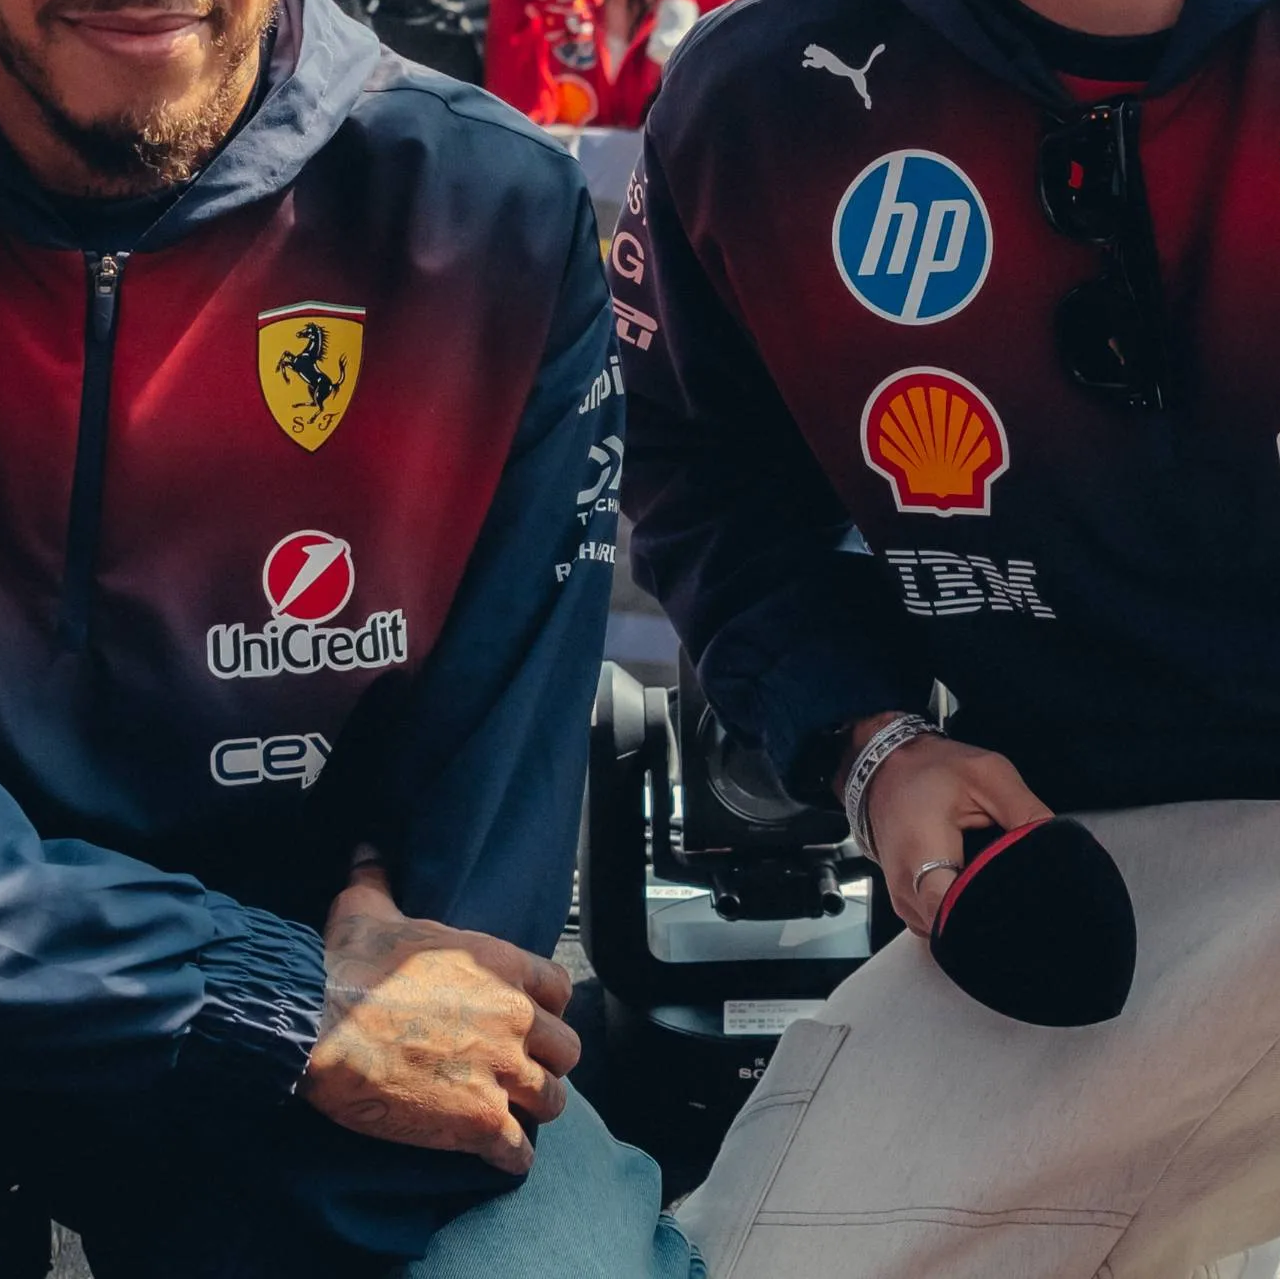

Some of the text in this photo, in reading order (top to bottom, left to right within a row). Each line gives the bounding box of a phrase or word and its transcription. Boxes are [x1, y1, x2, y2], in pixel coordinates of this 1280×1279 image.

[858, 154, 971, 320] hp
[885, 549, 1058, 619] IBM
[212, 613, 406, 674] UniCredit
